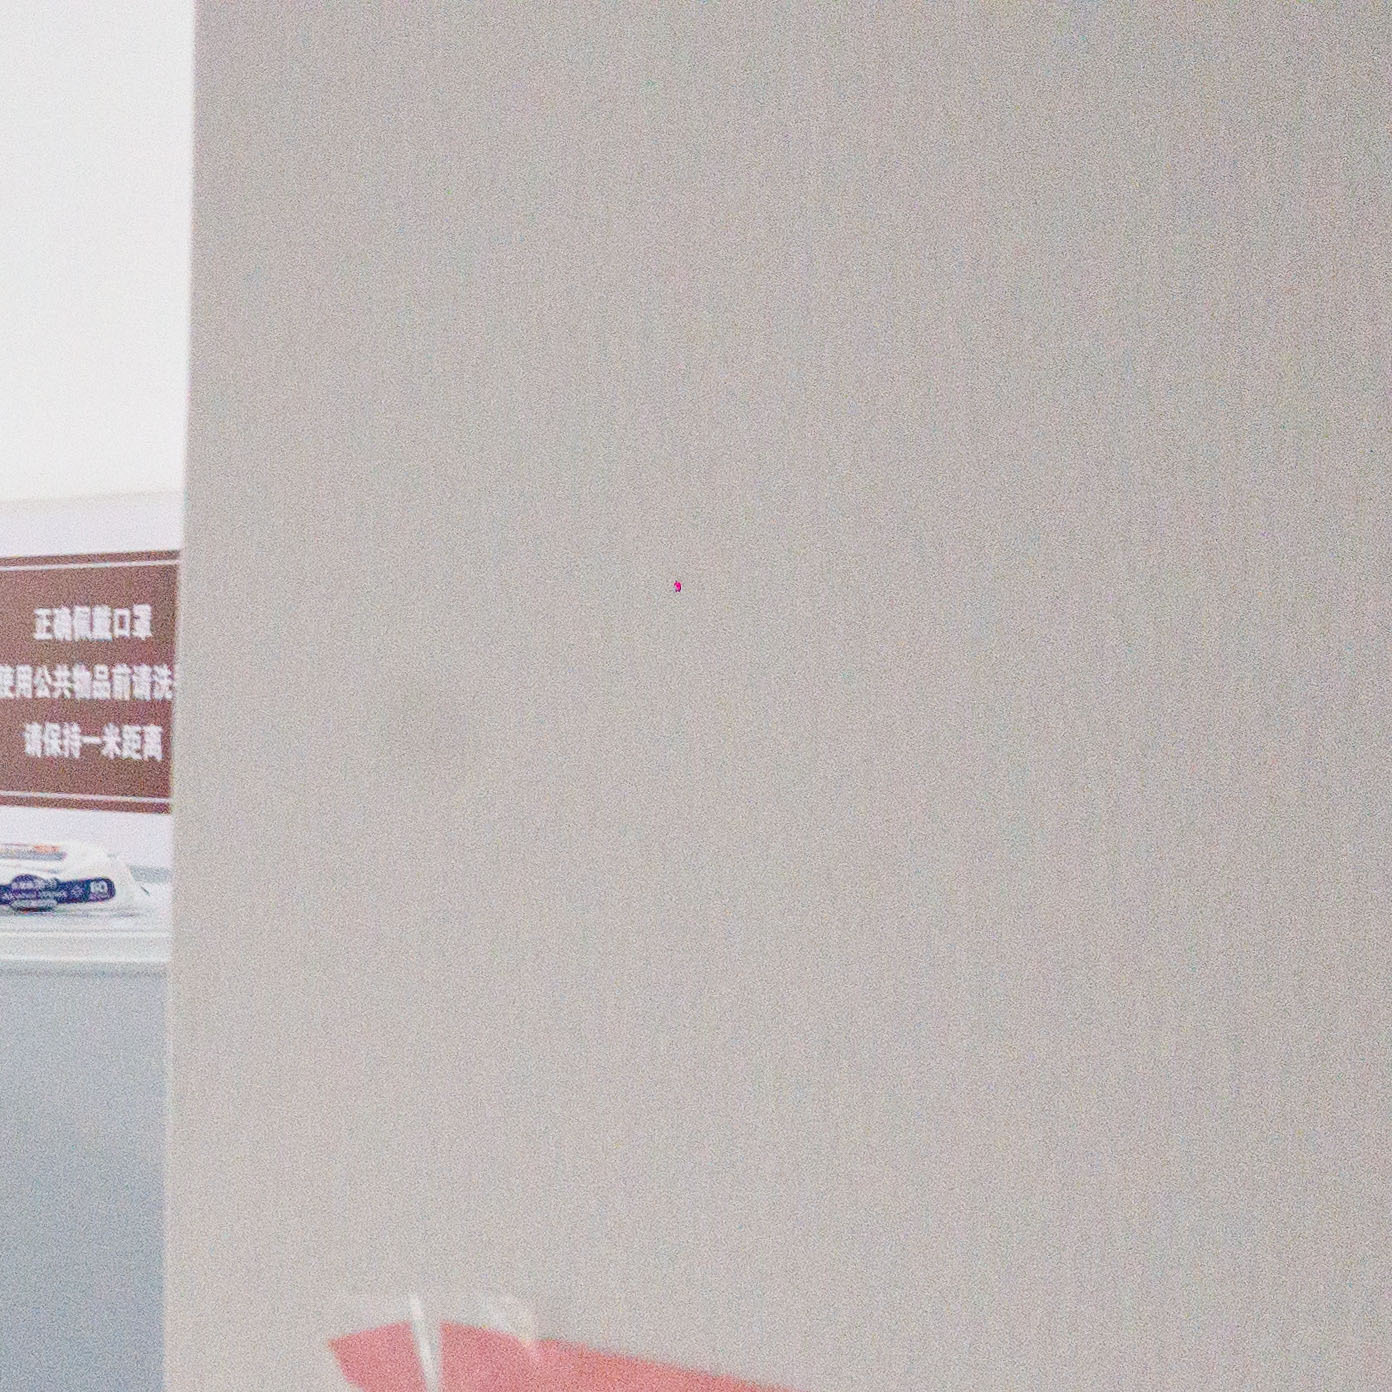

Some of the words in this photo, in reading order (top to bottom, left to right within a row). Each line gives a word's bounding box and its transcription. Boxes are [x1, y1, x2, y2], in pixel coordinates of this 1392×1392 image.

[23, 721, 163, 762] 请保持一米距离
